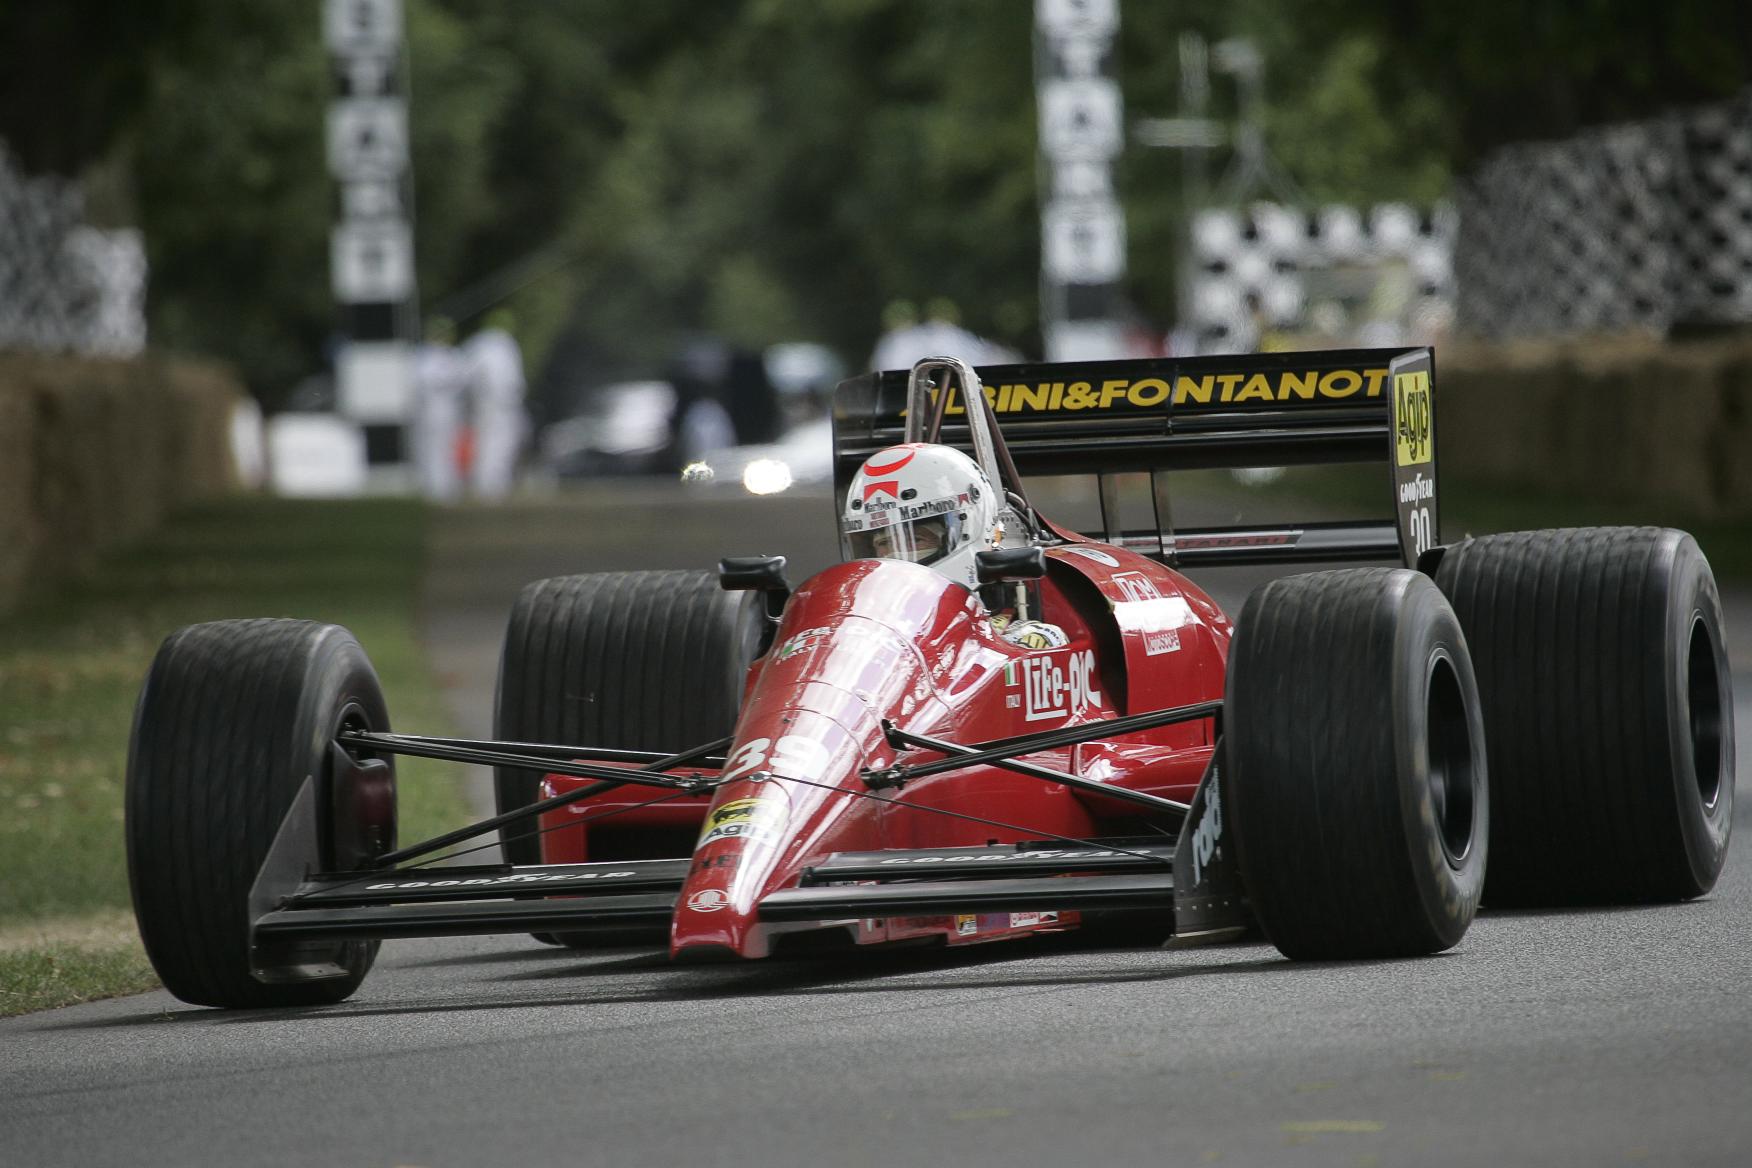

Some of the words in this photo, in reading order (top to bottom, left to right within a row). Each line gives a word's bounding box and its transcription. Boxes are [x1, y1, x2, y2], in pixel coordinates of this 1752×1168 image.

[1399, 376, 1428, 462] Agip
[899, 499, 955, 521] Marlboro
[880, 849, 1151, 864] GOODYEAR
[365, 871, 637, 890] GOODYEAR
